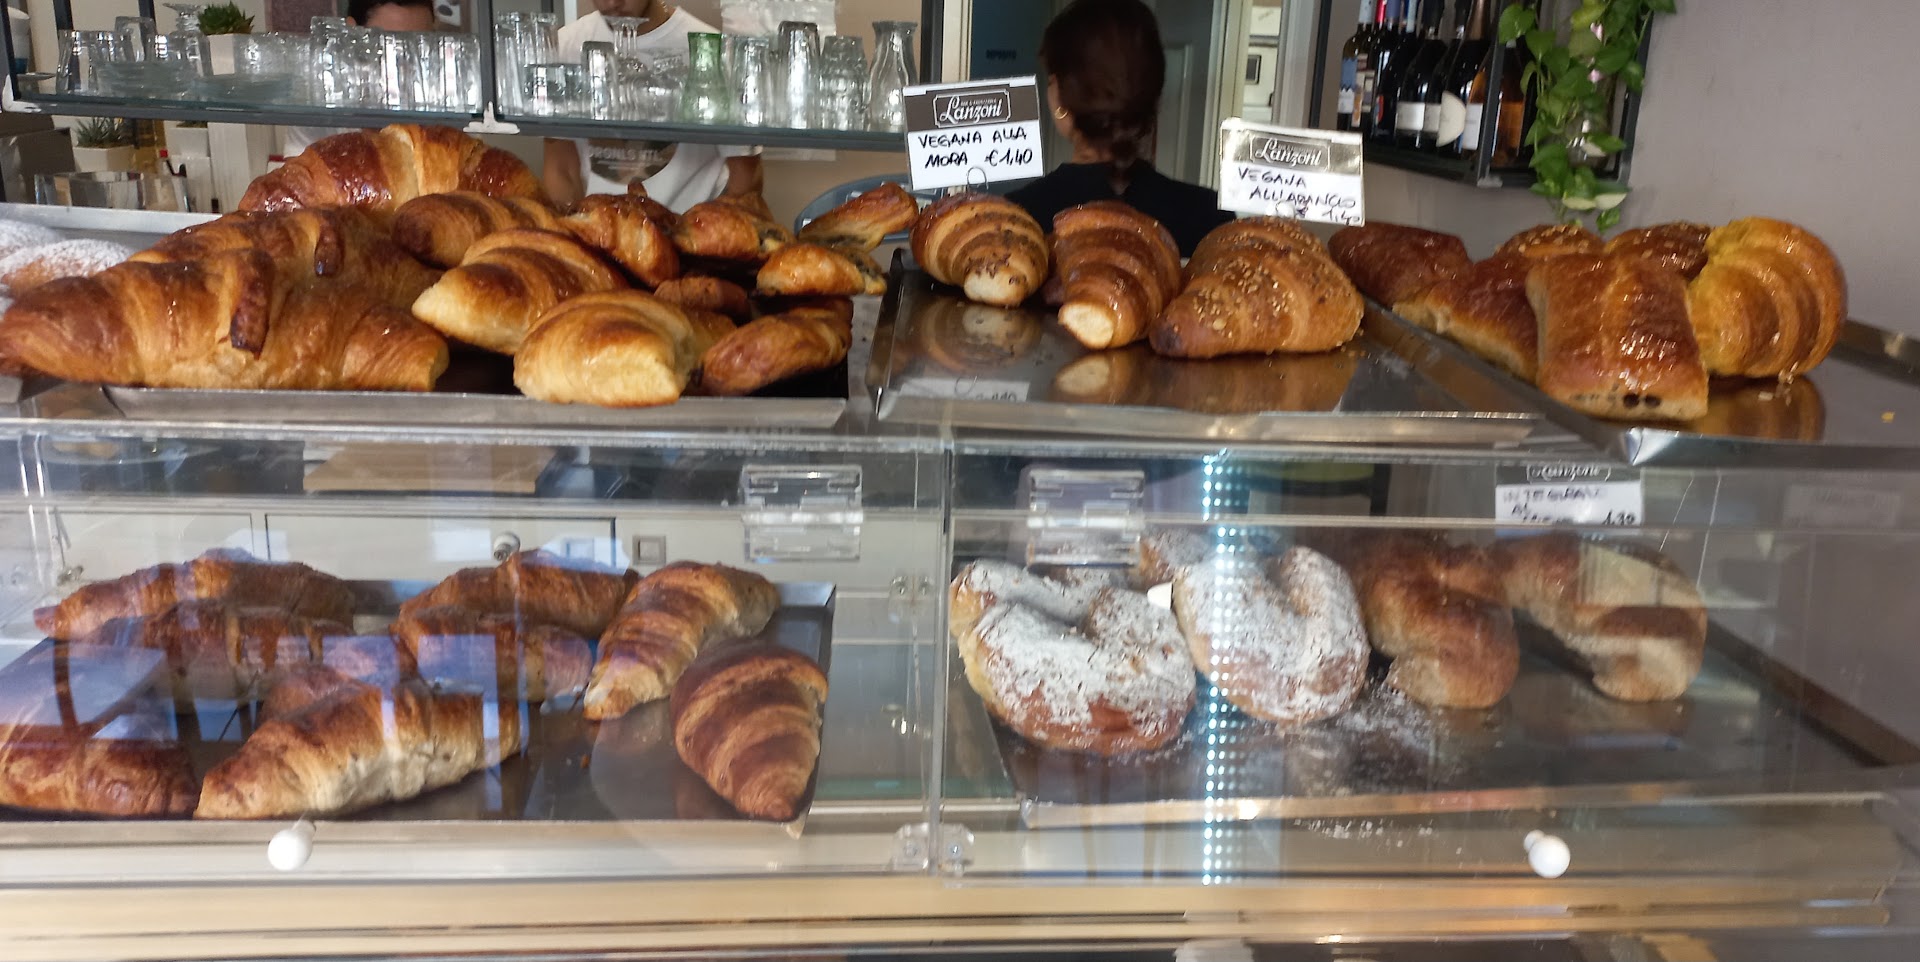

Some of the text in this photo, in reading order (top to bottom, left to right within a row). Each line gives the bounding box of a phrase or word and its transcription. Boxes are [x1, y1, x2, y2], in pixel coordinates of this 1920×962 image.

[940, 95, 1002, 124] Lanzoni
[918, 131, 982, 149] VEGANA
[925, 151, 968, 169] MORA
[1255, 138, 1322, 167] Lanzoni
[1238, 167, 1307, 188] VEGANA
